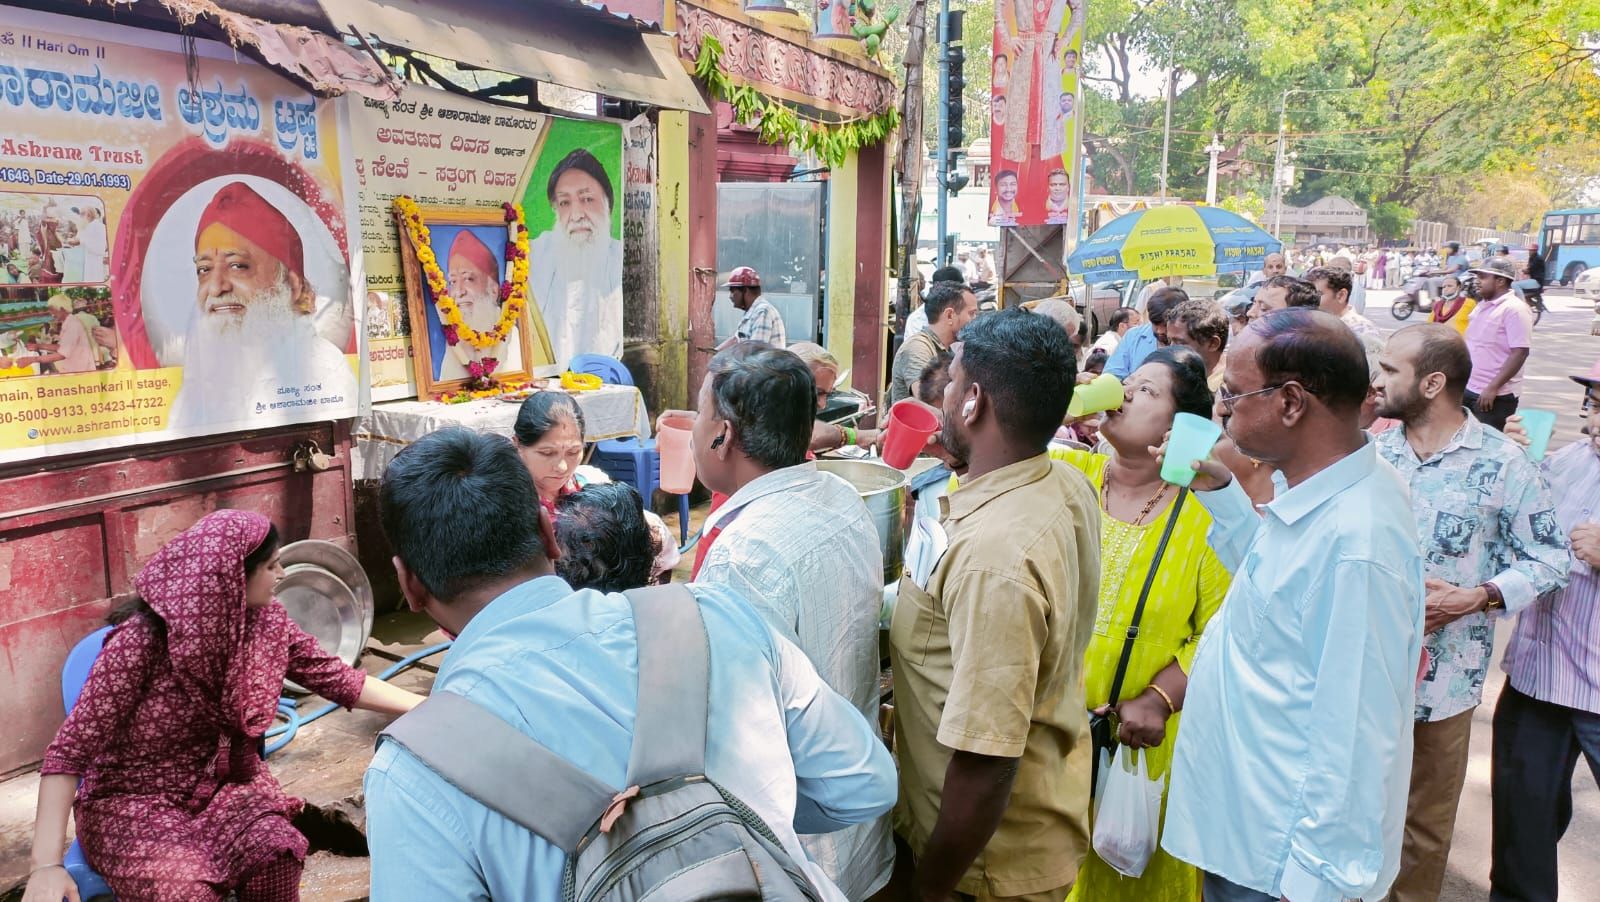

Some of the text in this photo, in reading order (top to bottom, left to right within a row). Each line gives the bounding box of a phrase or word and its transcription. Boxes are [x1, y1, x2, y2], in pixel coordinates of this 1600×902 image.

[37, 39, 63, 53] Hari
[67, 43, 89, 56] Om
[0, 63, 318, 159] ಾರಾಮಜೀ ಆಶ್ರಮ ಟ್ರಸ್ಟ್
[392, 100, 417, 114] ಸಂತ
[419, 103, 433, 120] ಶ್ರೀ
[438, 108, 491, 125] ಆಶಾರಾಮಜೀ
[1, 138, 144, 165] Ashram Trust
[450, 135, 490, 154] ದಿವಸ
[35, 169, 131, 192] Date-29.01.1993)
[372, 154, 409, 179] ಸೇವೆ
[435, 166, 477, 192] ಸತ್ಸಂಗ
[484, 169, 517, 187] ದಿವಸ
[1165, 248, 1197, 259] PRASAD
[37, 380, 123, 399] Banashankari
[137, 378, 171, 390] stage,
[304, 383, 322, 392] ಸಂತ
[90, 397, 167, 414] 93423-47322.
[256, 402, 266, 414] ಶ್ರೀ
[39, 415, 161, 437] www.ashramblr.org
